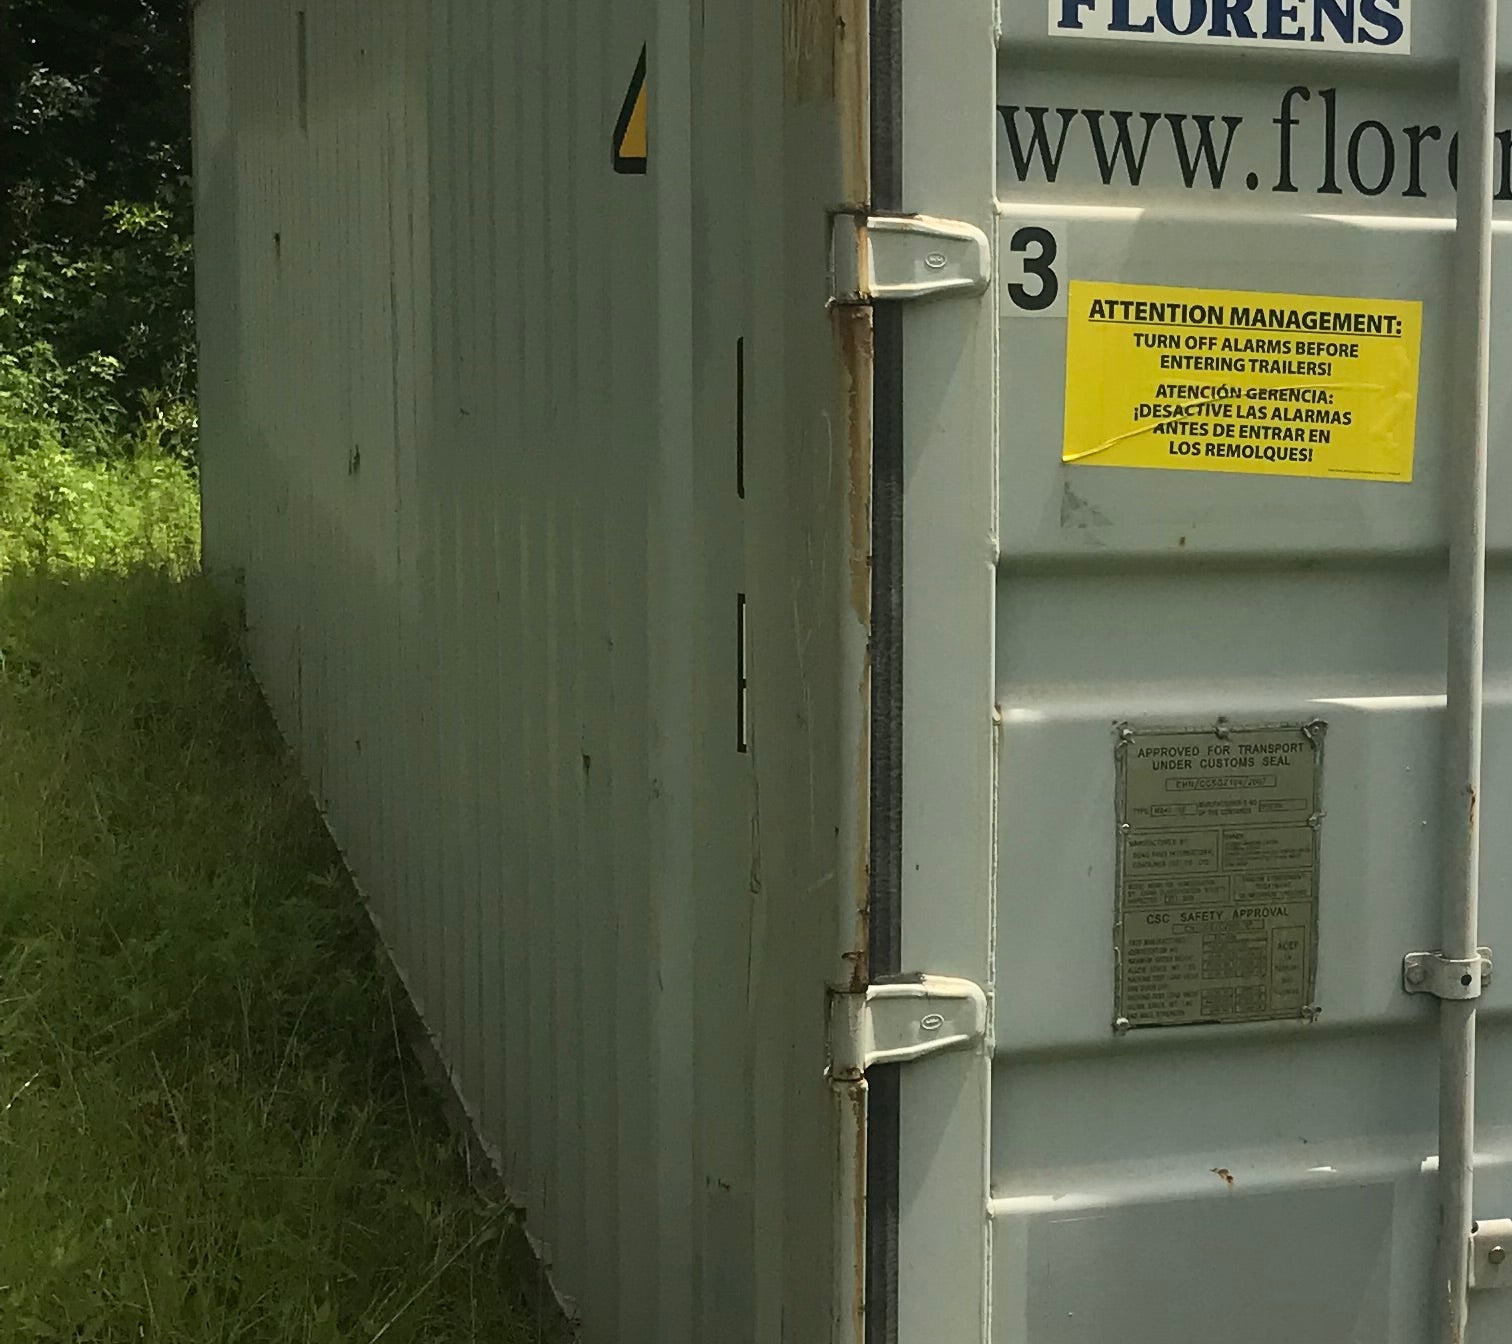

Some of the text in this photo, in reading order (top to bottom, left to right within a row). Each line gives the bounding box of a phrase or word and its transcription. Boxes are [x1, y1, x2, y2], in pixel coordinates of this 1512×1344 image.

[1009, 225, 1059, 311] 3
[1089, 299, 1402, 334] ATTENTION MANAGEMENT:
[1134, 333, 1358, 358] TURN OFF ALARMS BEFORE
[1160, 355, 1332, 376] ENTERING TRAILERS!
[1156, 383, 1333, 404] ATENCIÓN GERENCIA:
[1134, 404, 1351, 425] ¡DESACTIVE LAS ALARMAS
[1153, 422, 1330, 444] ANTES DE ENTRAR EN
[1169, 441, 1313, 462] LOS REMOLQUES!
[1137, 742, 1304, 758] APPROVED FOR TRANSPORT
[1152, 755, 1290, 771] UNDER CUSTOMS SEAL
[1146, 907, 1289, 925] CSC SAFETY APPROVAL
